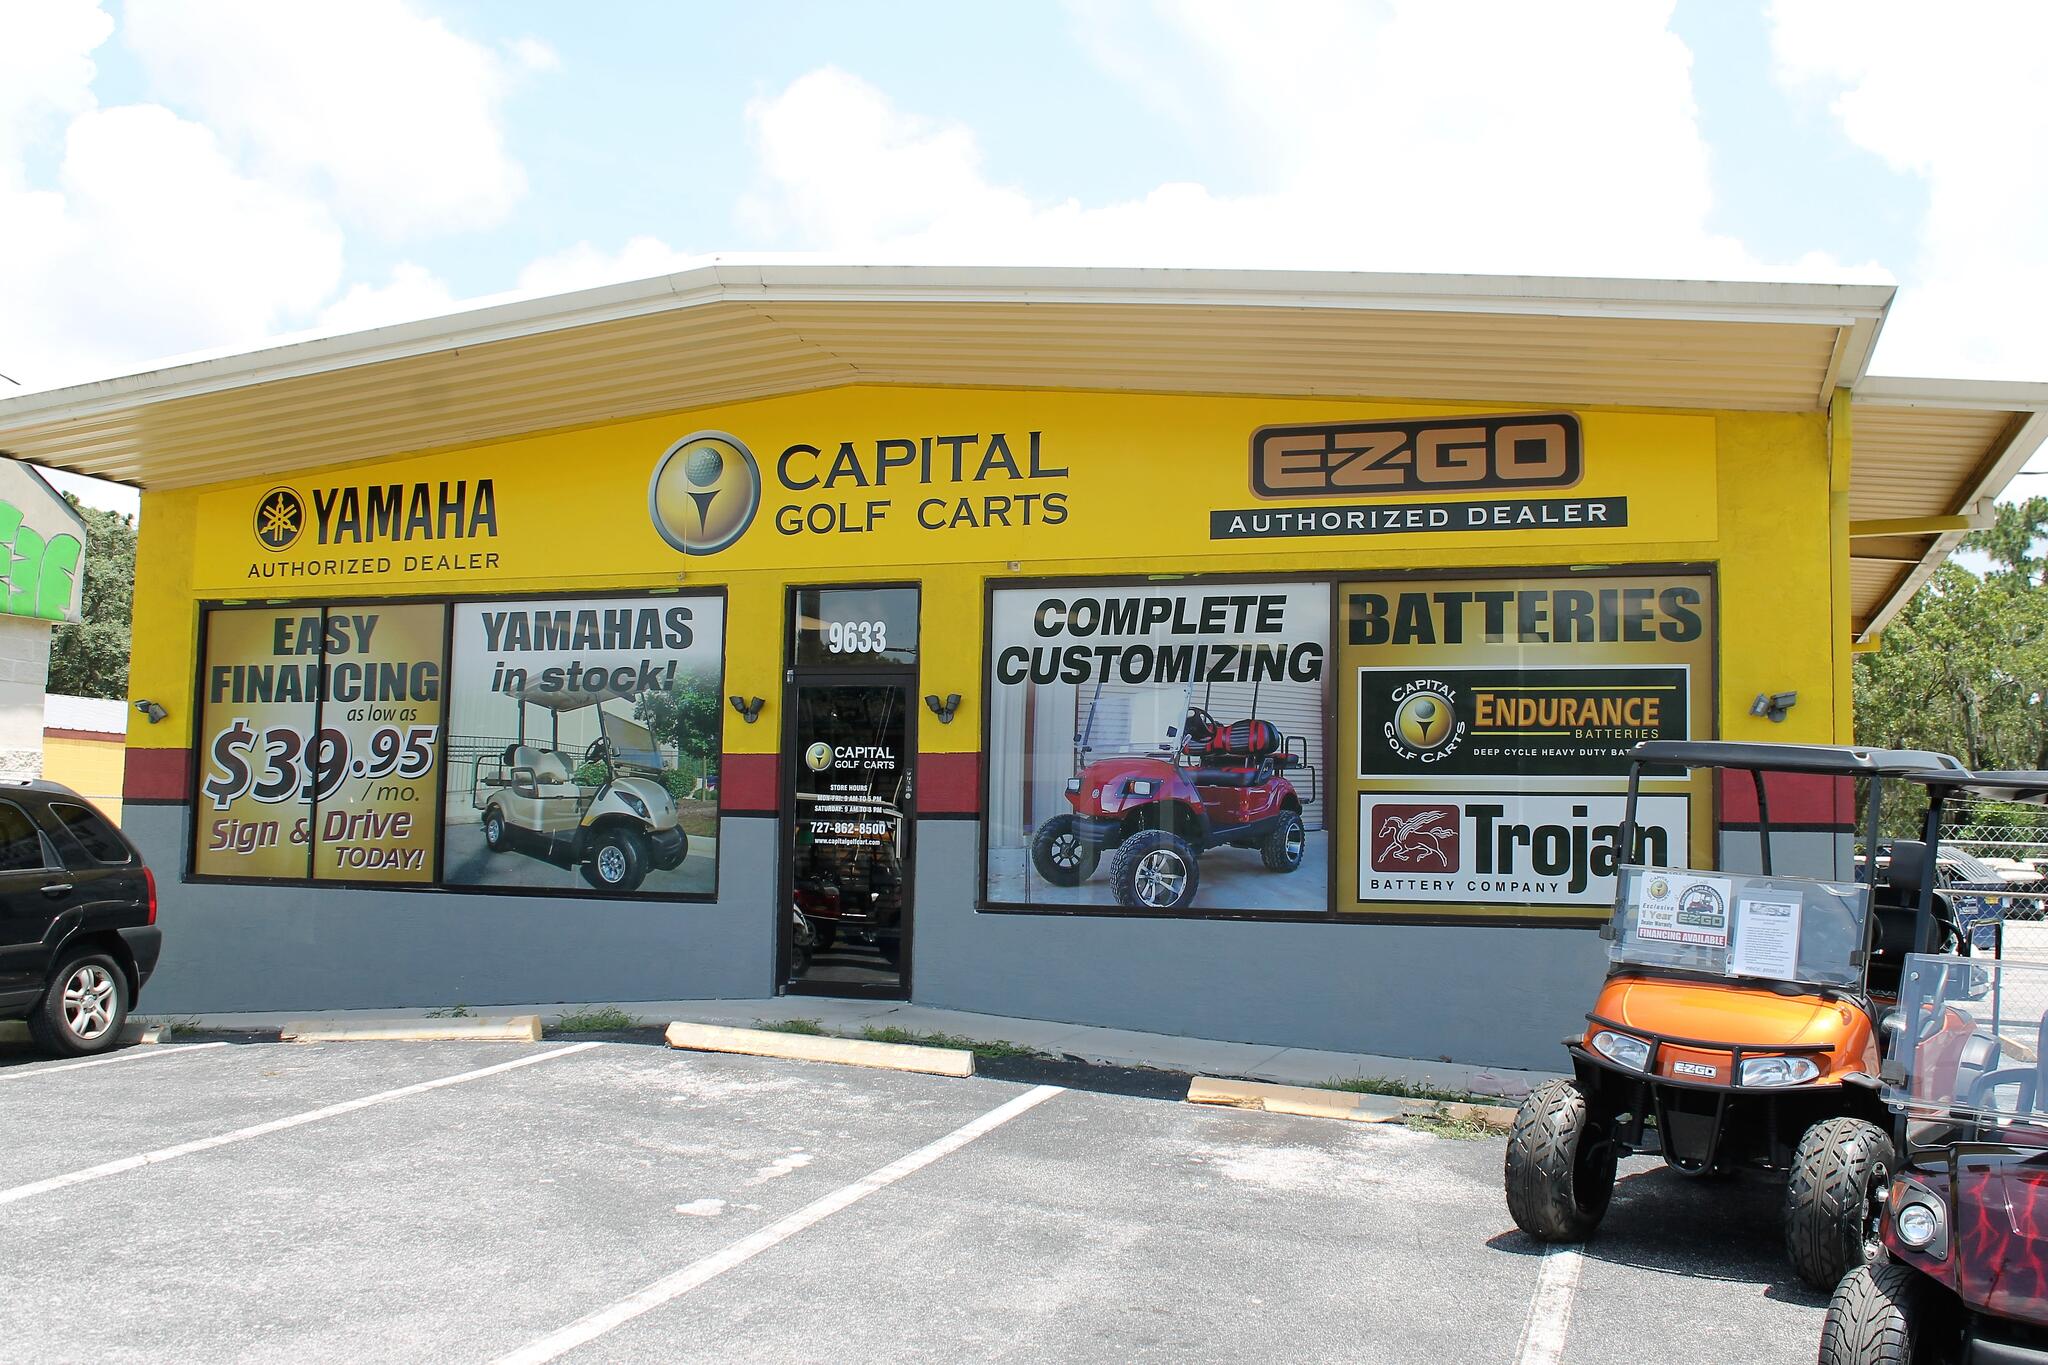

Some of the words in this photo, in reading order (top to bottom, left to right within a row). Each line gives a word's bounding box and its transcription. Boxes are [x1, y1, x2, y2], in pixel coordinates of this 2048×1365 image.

[776, 431, 1069, 491] CAPITAL
[1263, 423, 1567, 490] EZGO
[312, 478, 498, 545] YAMAHA
[774, 499, 891, 536] GOLF
[916, 492, 1069, 530] CARTS
[1228, 508, 1449, 534] AUTHORIZED
[1468, 503, 1608, 526] DEALER
[248, 557, 391, 579] AUTHORIZED
[403, 552, 500, 572] DEALER
[481, 607, 694, 652] YAMAHAS
[1033, 595, 1288, 637] COMPLETE
[1347, 587, 1703, 645] BATTERIES
[273, 615, 380, 656] EASY
[828, 621, 887, 653] 9633
[491, 661, 528, 692] in
[540, 659, 678, 693] stock!
[996, 641, 1325, 685] CUSTOMIZING
[210, 661, 440, 704] FINANCING
[1391, 679, 1457, 704] CAPITAL
[347, 708, 364, 722] as
[367, 705, 396, 722] low
[399, 706, 418, 722] as
[1475, 693, 1661, 728] ENDURANCE
[1384, 721, 1418, 760] GOLF
[1420, 721, 1466, 763] CARTS
[1575, 729, 1660, 739] BATTERIES
[202, 718, 439, 810] $39.95
[834, 746, 895, 759] CAPITAL
[834, 760, 860, 769] GOLF
[863, 760, 895, 769] CARTS
[1473, 748, 1500, 756] DEEP
[1504, 748, 1537, 756] CYCLE
[1541, 748, 1575, 756] HEAVY
[1579, 748, 1607, 756] DUTY
[209, 818, 281, 855] Sign
[289, 817, 310, 844] &
[322, 809, 413, 844] Drive
[810, 821, 886, 835] 727-862-8500
[335, 846, 425, 871] TODAY!
[1464, 804, 1668, 894] Trojan
[1371, 879, 1455, 891] BATTERY
[1467, 880, 1560, 893] COMPANY
[1643, 903, 1674, 911] Exclusive
[1649, 910, 1672, 920] Year
[1640, 928, 1681, 941] FINANCING
[1682, 932, 1724, 945] AVAILABLE
[1675, 1062, 1716, 1077] EZGO
